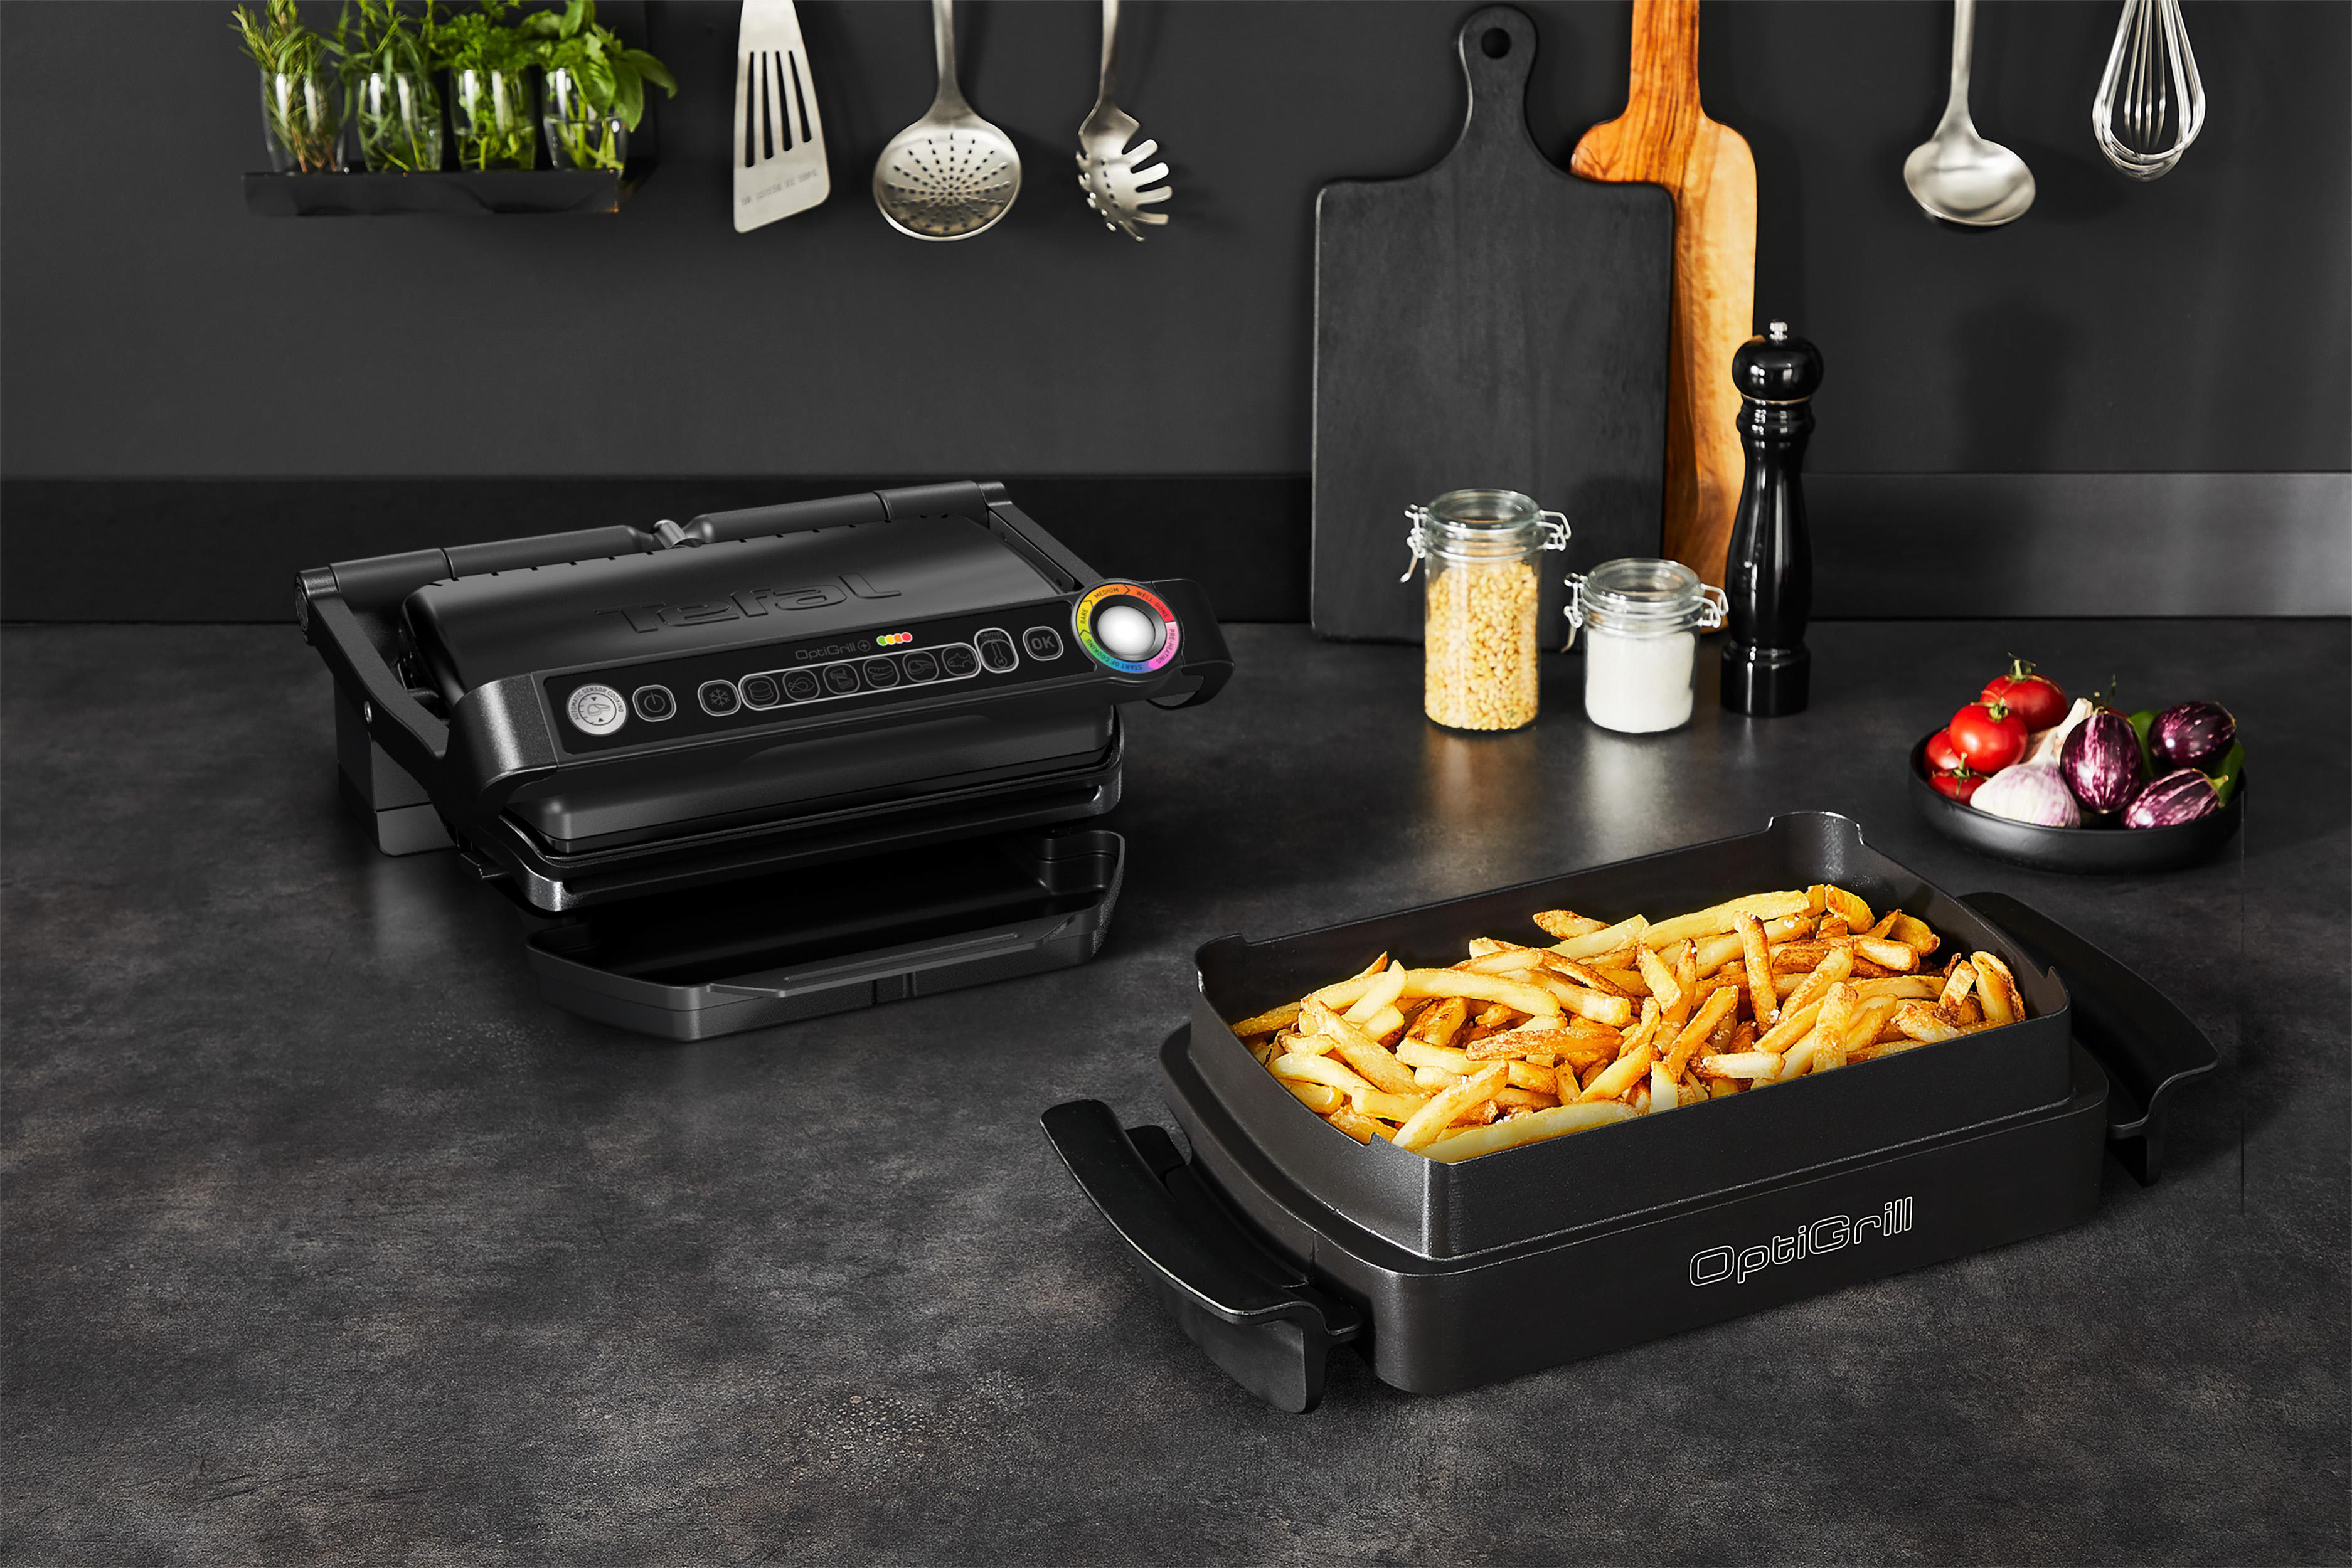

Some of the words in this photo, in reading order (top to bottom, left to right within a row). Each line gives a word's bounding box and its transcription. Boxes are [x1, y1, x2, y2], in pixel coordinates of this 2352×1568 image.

[594, 572, 901, 633] Tefal
[1094, 587, 1119, 598] MEDIUM
[1136, 590, 1169, 618] WELL-DONE
[1080, 609, 1089, 624] RARE
[795, 642, 856, 660] OptiGrill
[1031, 635, 1055, 650] OK
[1085, 638, 1110, 662] COOKING
[1156, 628, 1175, 664] PRE-HEATING
[570, 692, 582, 720] AUTOMATIC
[607, 691, 624, 713] COOKING
[1690, 1195, 1913, 1287] OptiGrill
